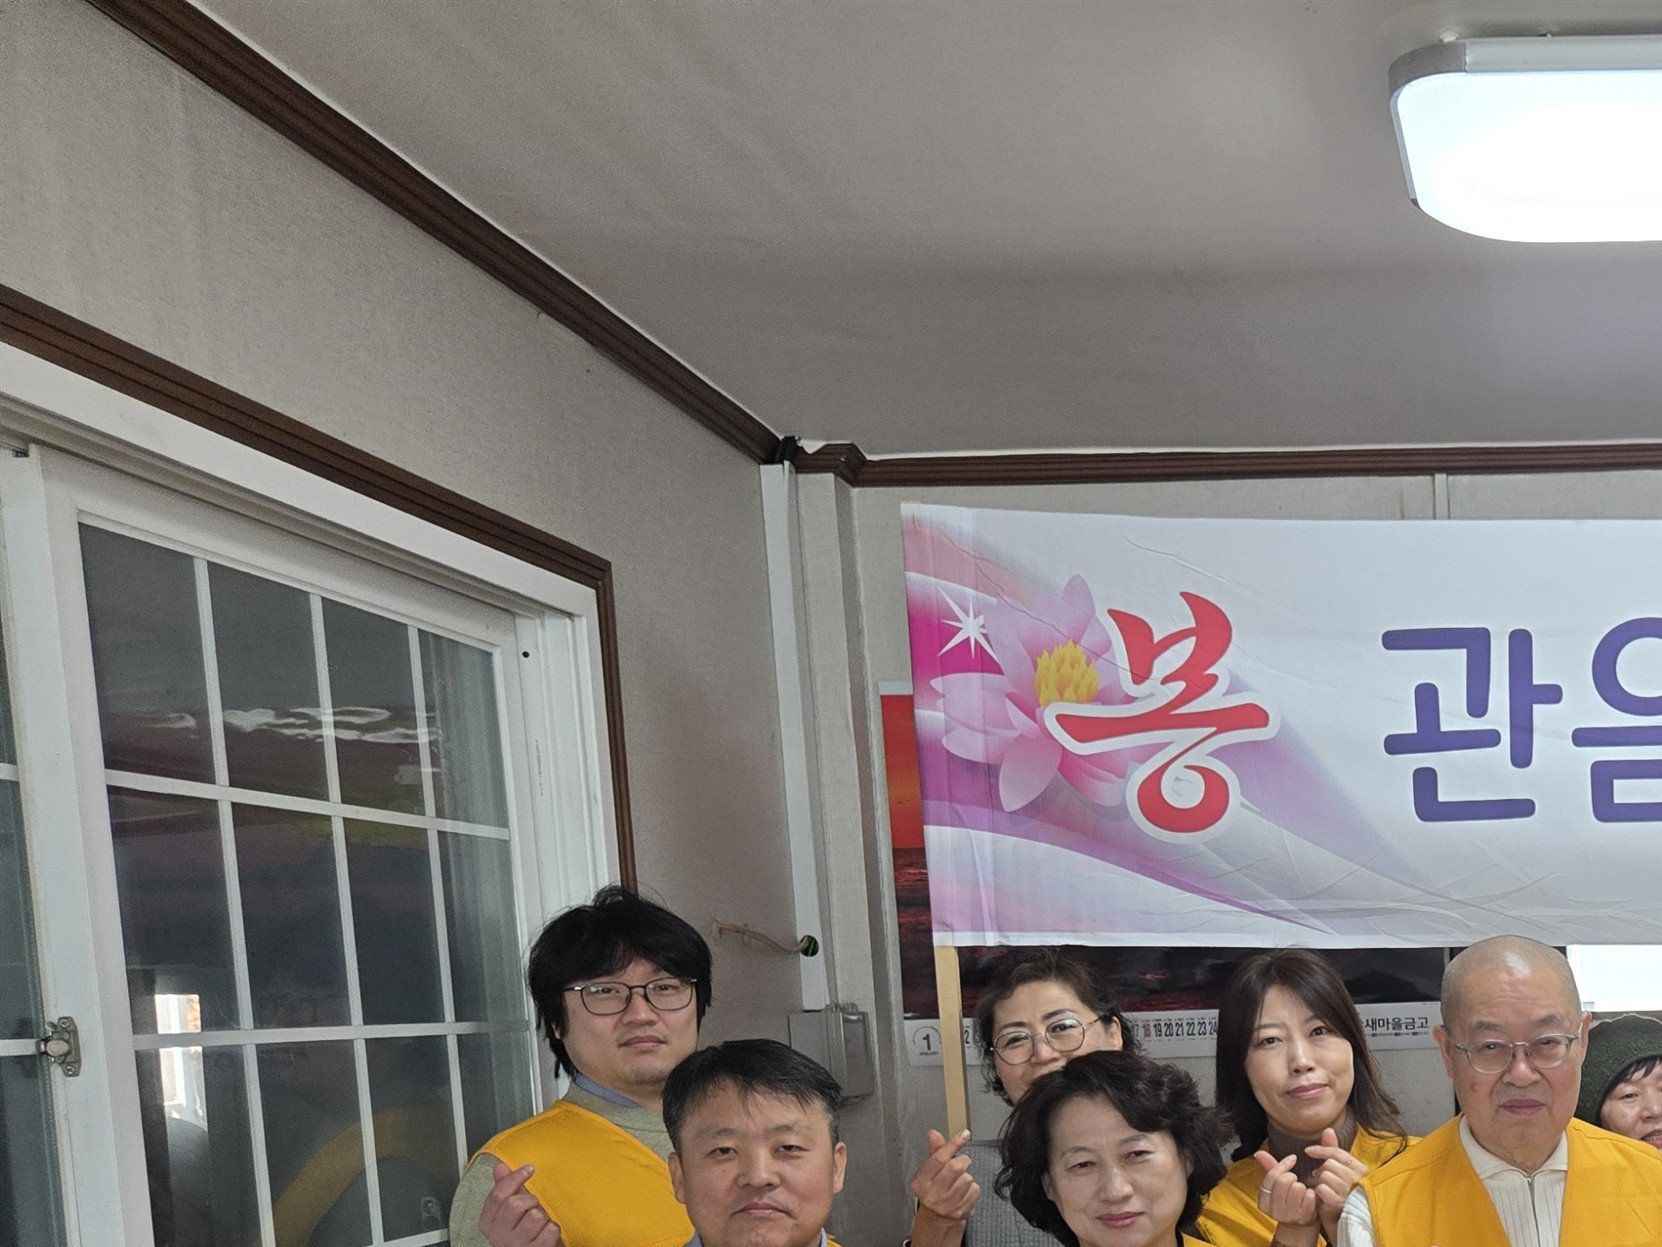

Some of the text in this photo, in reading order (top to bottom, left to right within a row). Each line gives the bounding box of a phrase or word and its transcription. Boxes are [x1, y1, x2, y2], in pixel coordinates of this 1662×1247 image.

[1056, 592, 1271, 834] 봉
[1142, 1024, 1151, 1038] 18
[1153, 1023, 1162, 1037] 19
[1164, 1022, 1173, 1037] 20
[1175, 1022, 1184, 1036] 21
[1186, 1022, 1196, 1036] 22
[1198, 1021, 1207, 1035] 23
[1209, 1021, 1217, 1035] 24
[1365, 1017, 1429, 1031] 새마을금고
[923, 1034, 931, 1050] 1
